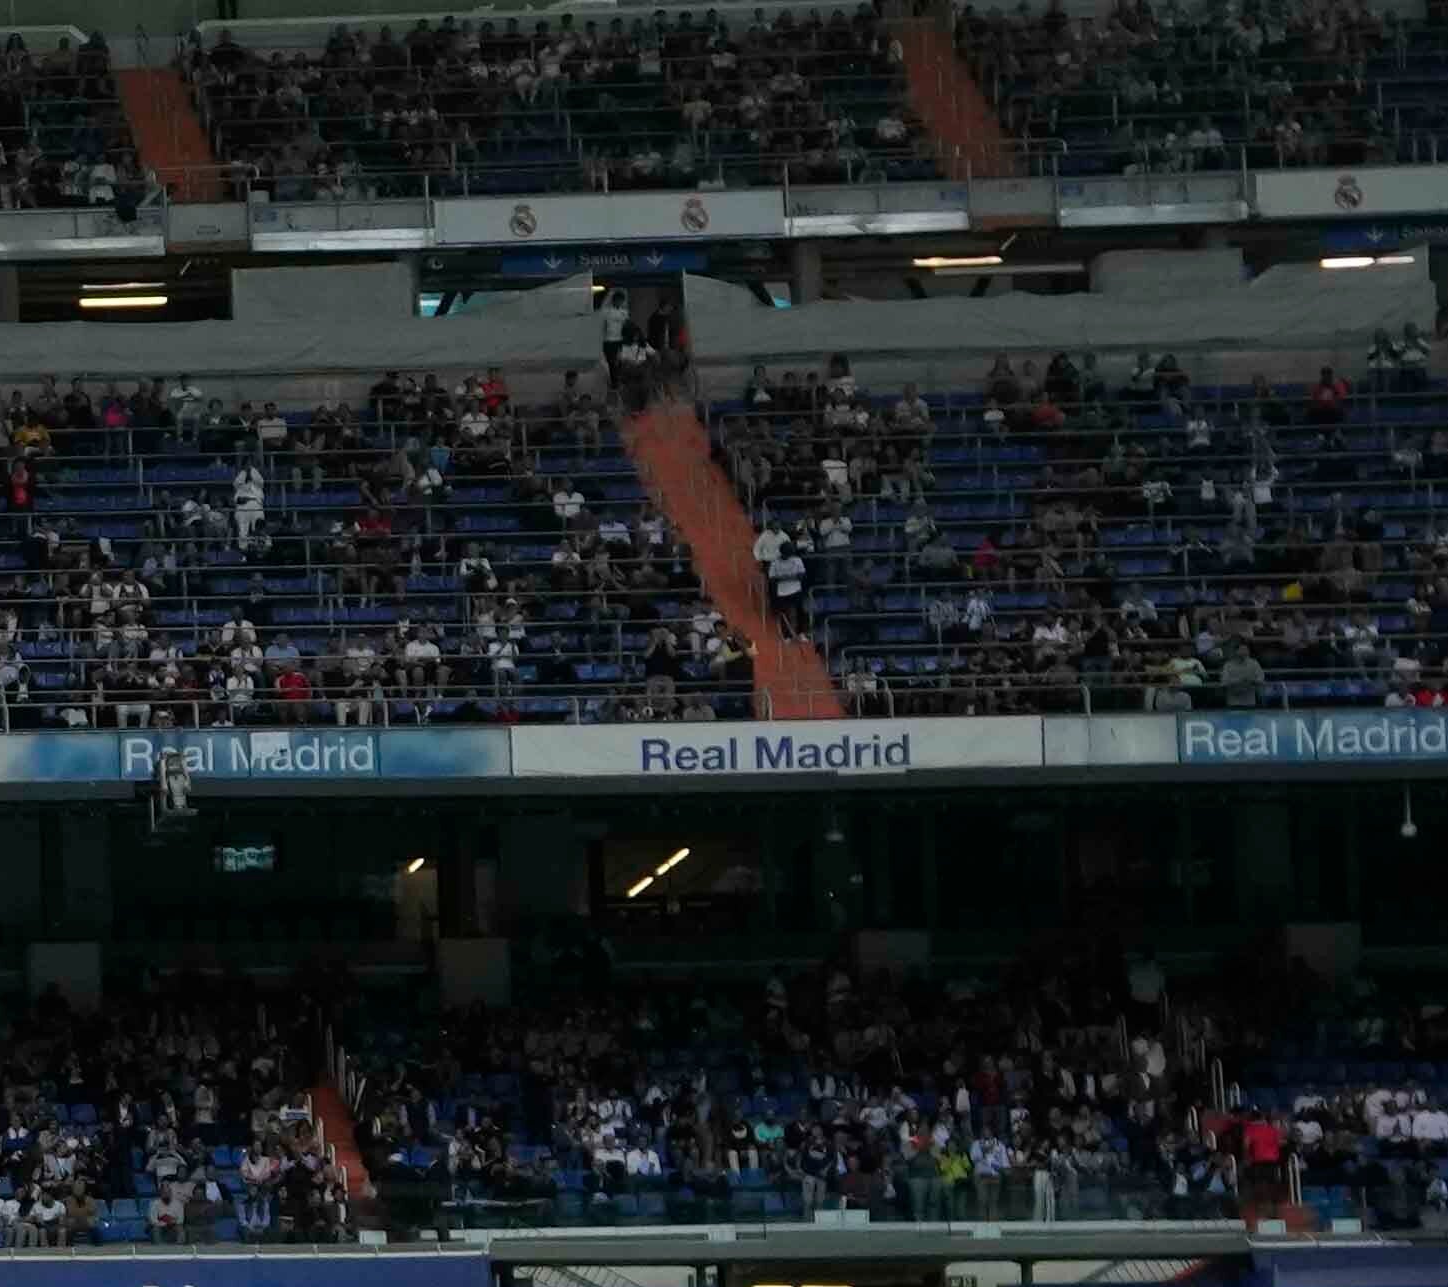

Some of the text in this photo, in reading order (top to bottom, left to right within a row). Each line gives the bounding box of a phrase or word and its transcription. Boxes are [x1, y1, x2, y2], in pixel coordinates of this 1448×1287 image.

[642, 733, 910, 769] Real Madrid
[1186, 717, 1447, 756] Real Madrid
[125, 738, 213, 772] Ral
